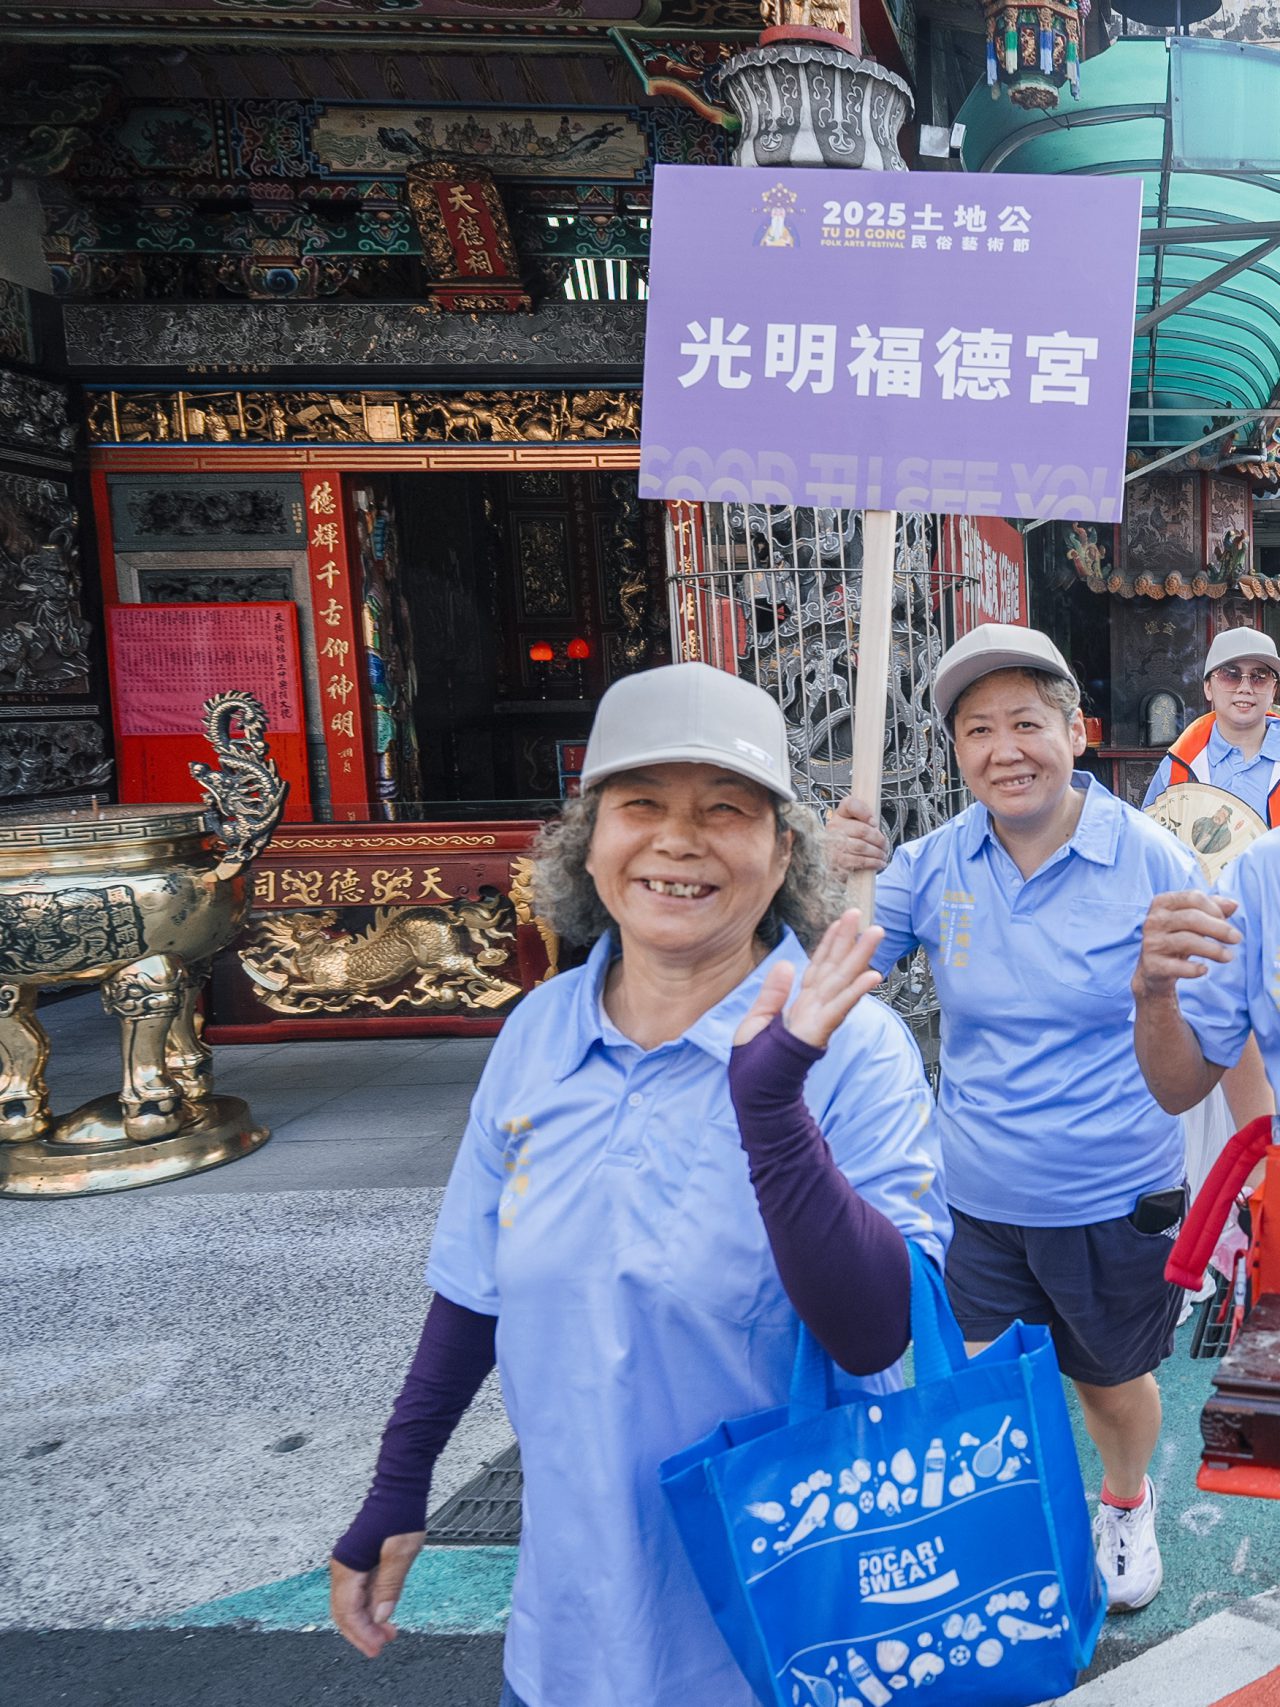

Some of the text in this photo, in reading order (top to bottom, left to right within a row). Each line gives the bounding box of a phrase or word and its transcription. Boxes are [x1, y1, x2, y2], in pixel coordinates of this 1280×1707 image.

[447, 185, 495, 276] 天德祠
[821, 239, 841, 247] FOLK
[867, 240, 905, 249] FESTIVAL
[822, 227, 906, 241] TU DI GONG
[911, 235, 1030, 253] 民俗藝術節
[677, 317, 1099, 406] 光明福德宮
[858, 1535, 945, 1577] POCARI
[859, 1558, 938, 1597] SWEAT
